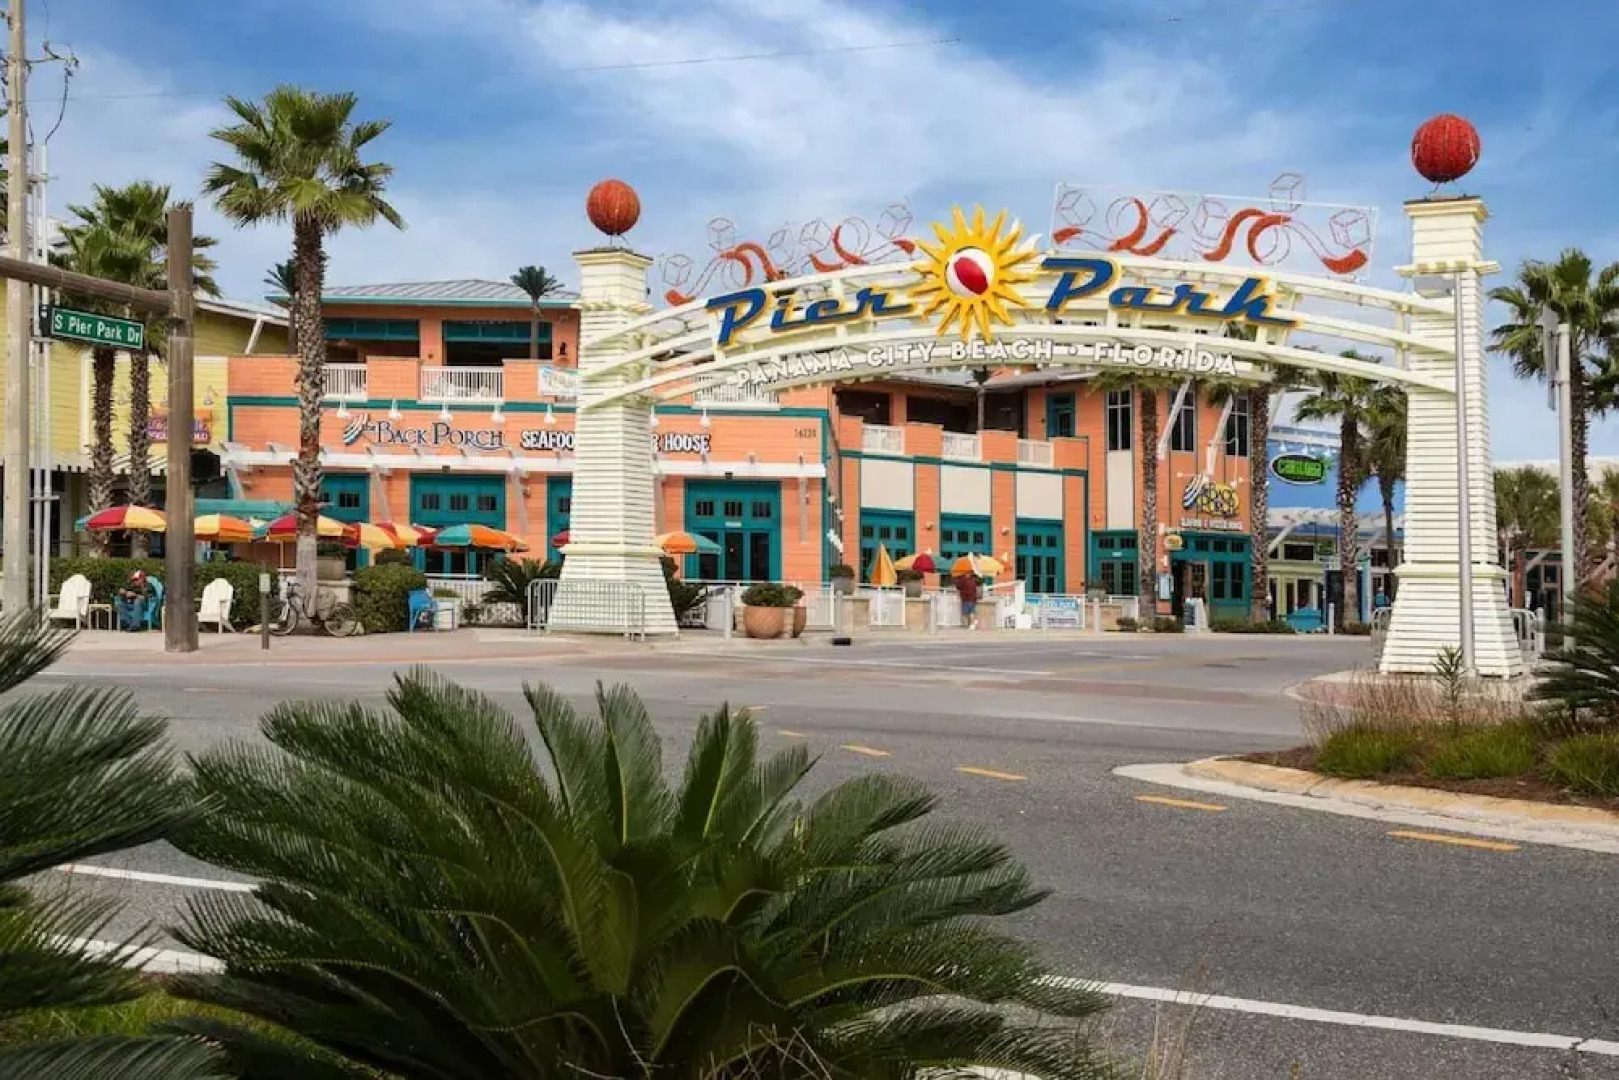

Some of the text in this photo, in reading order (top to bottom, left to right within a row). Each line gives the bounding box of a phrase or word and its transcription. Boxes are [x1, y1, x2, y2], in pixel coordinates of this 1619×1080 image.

[705, 256, 1301, 348] Pier Park
[54, 313, 140, 343] S Pier Park Dr
[736, 339, 1237, 389] PANAMA CITY BEACH FLORIDA
[521, 431, 574, 450] SEAFOO
[663, 433, 711, 454] HOUSE
